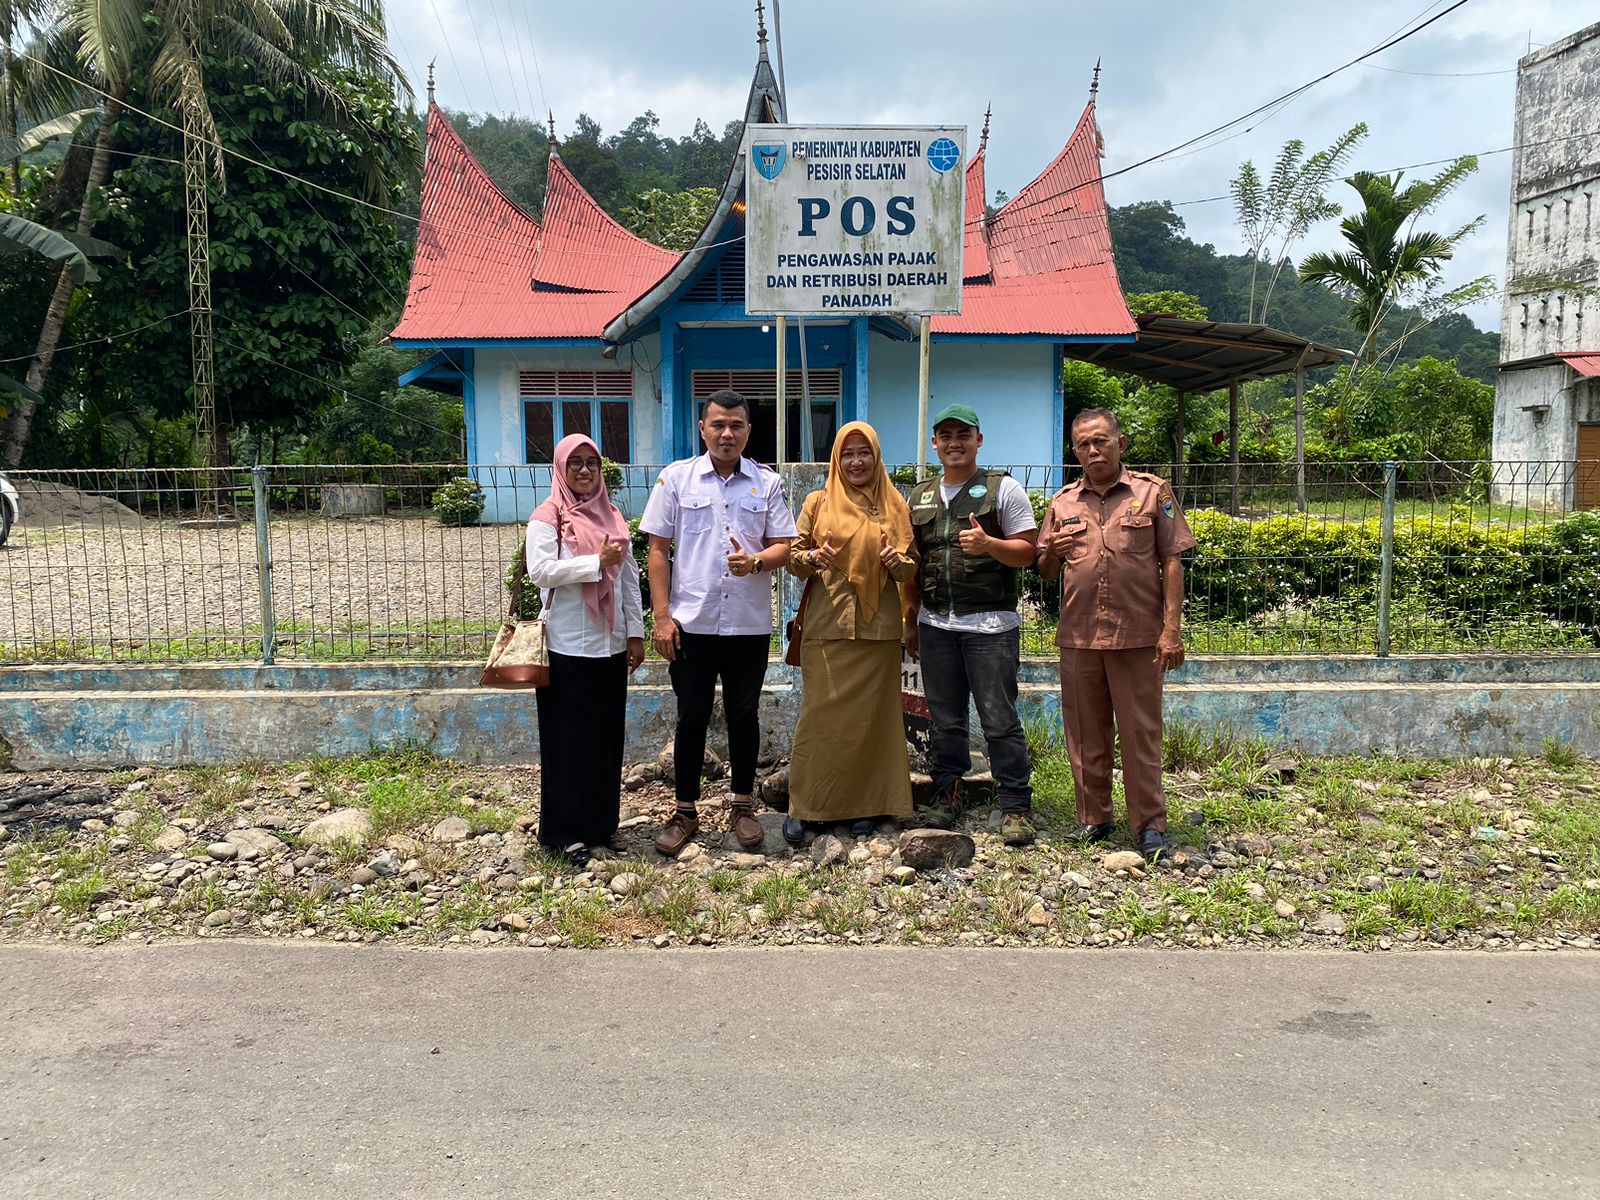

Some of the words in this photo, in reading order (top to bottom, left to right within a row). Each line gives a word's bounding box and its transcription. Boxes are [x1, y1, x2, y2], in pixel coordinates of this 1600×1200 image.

[792, 140, 858, 158] PEMERINTAH
[861, 140, 921, 157] KABUPATEN
[807, 163, 852, 180] PESISIR
[855, 163, 906, 180] SELATAN
[797, 196, 916, 237] POS
[778, 252, 884, 267] PENGAWASAN
[888, 252, 937, 266] PAJAK
[767, 275, 797, 288] DAN
[802, 273, 882, 287] RETRIBUSI
[887, 272, 948, 286] DAERAH
[822, 294, 892, 307] PANADAH
